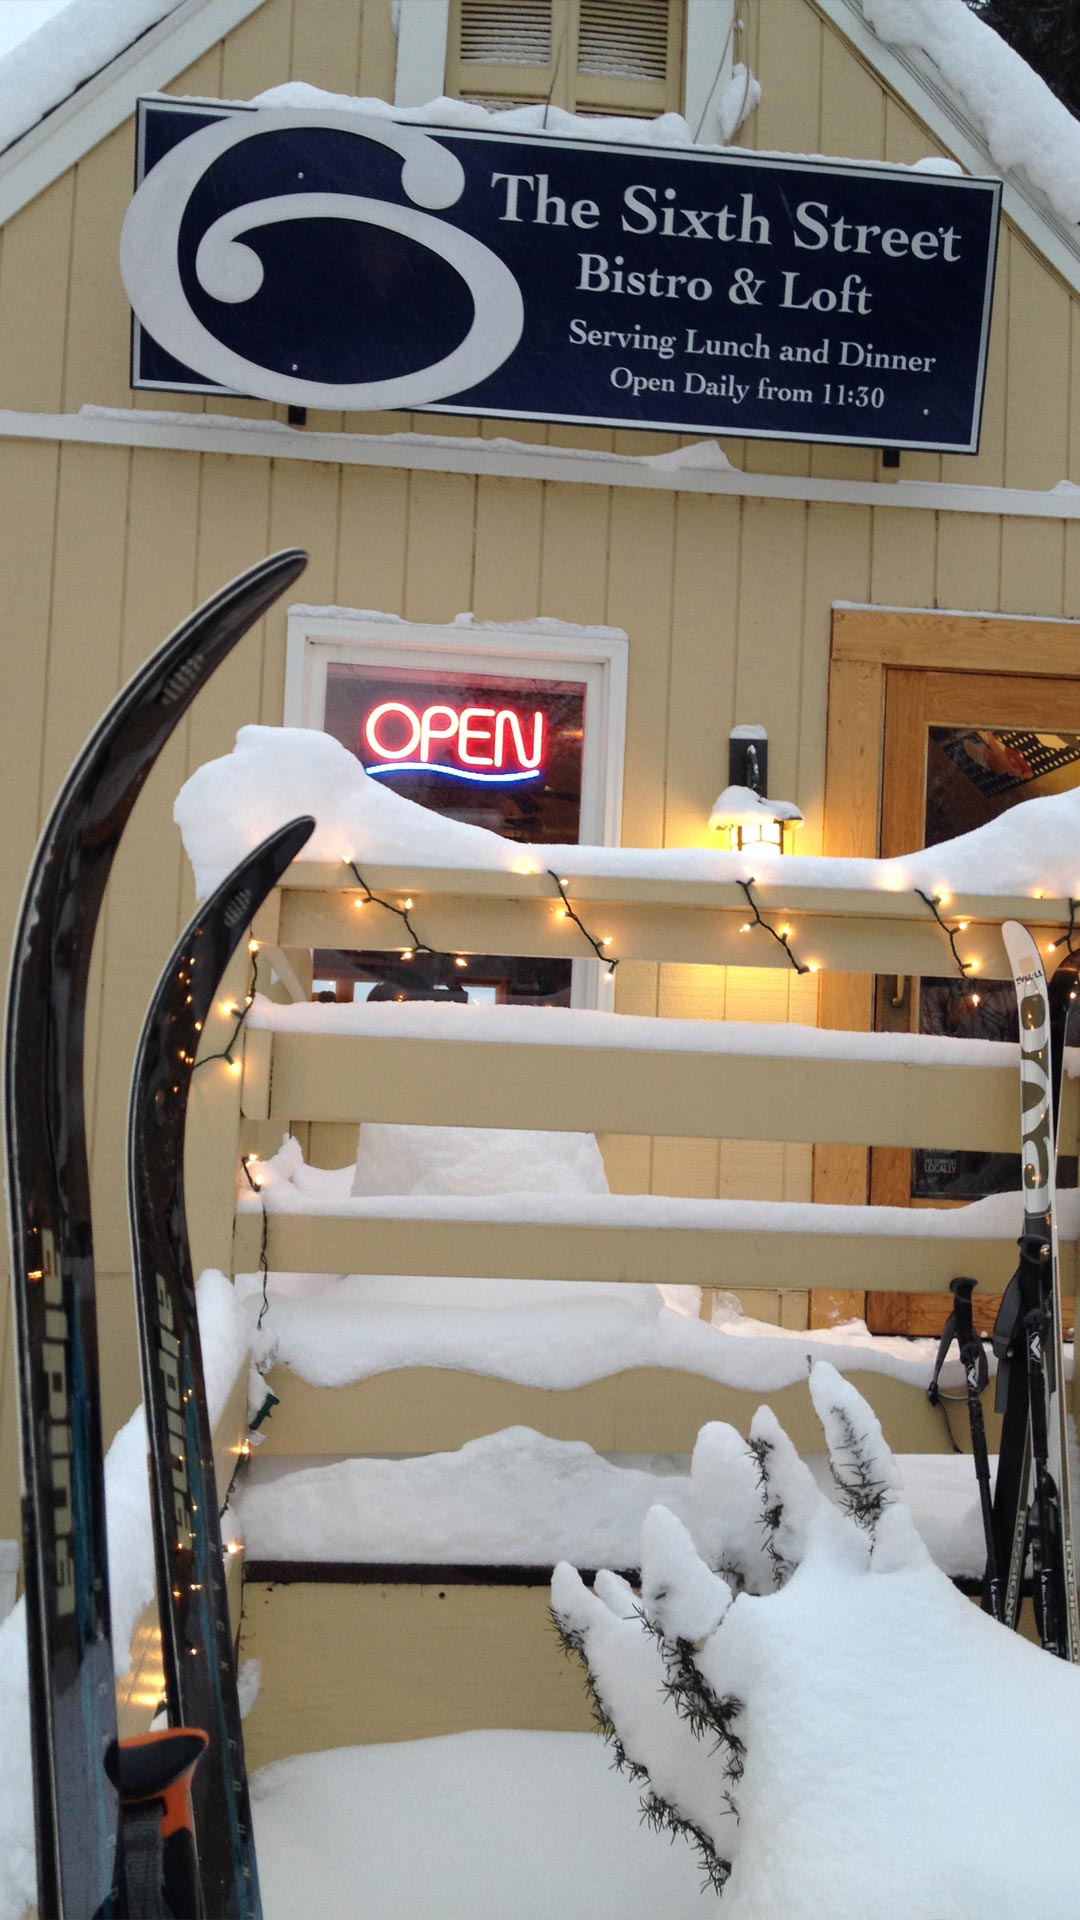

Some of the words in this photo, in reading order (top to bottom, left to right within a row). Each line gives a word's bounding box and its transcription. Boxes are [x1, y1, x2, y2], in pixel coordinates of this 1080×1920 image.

[490, 172, 601, 229] The
[621, 184, 772, 246] Sixth
[793, 201, 963, 263] Street
[575, 253, 714, 302] Bistro
[728, 267, 767, 307] &
[779, 271, 874, 316] Loft
[568, 318, 678, 360] Serving
[684, 328, 772, 361] Lunch
[779, 338, 830, 364] and
[838, 341, 938, 374] Dinner
[610, 366, 676, 396] Open
[683, 372, 751, 405] Daily
[757, 377, 813, 404] from
[824, 383, 886, 410] 11:30
[363, 699, 546, 770] OPEN
[155, 1272, 193, 1550] alpina
